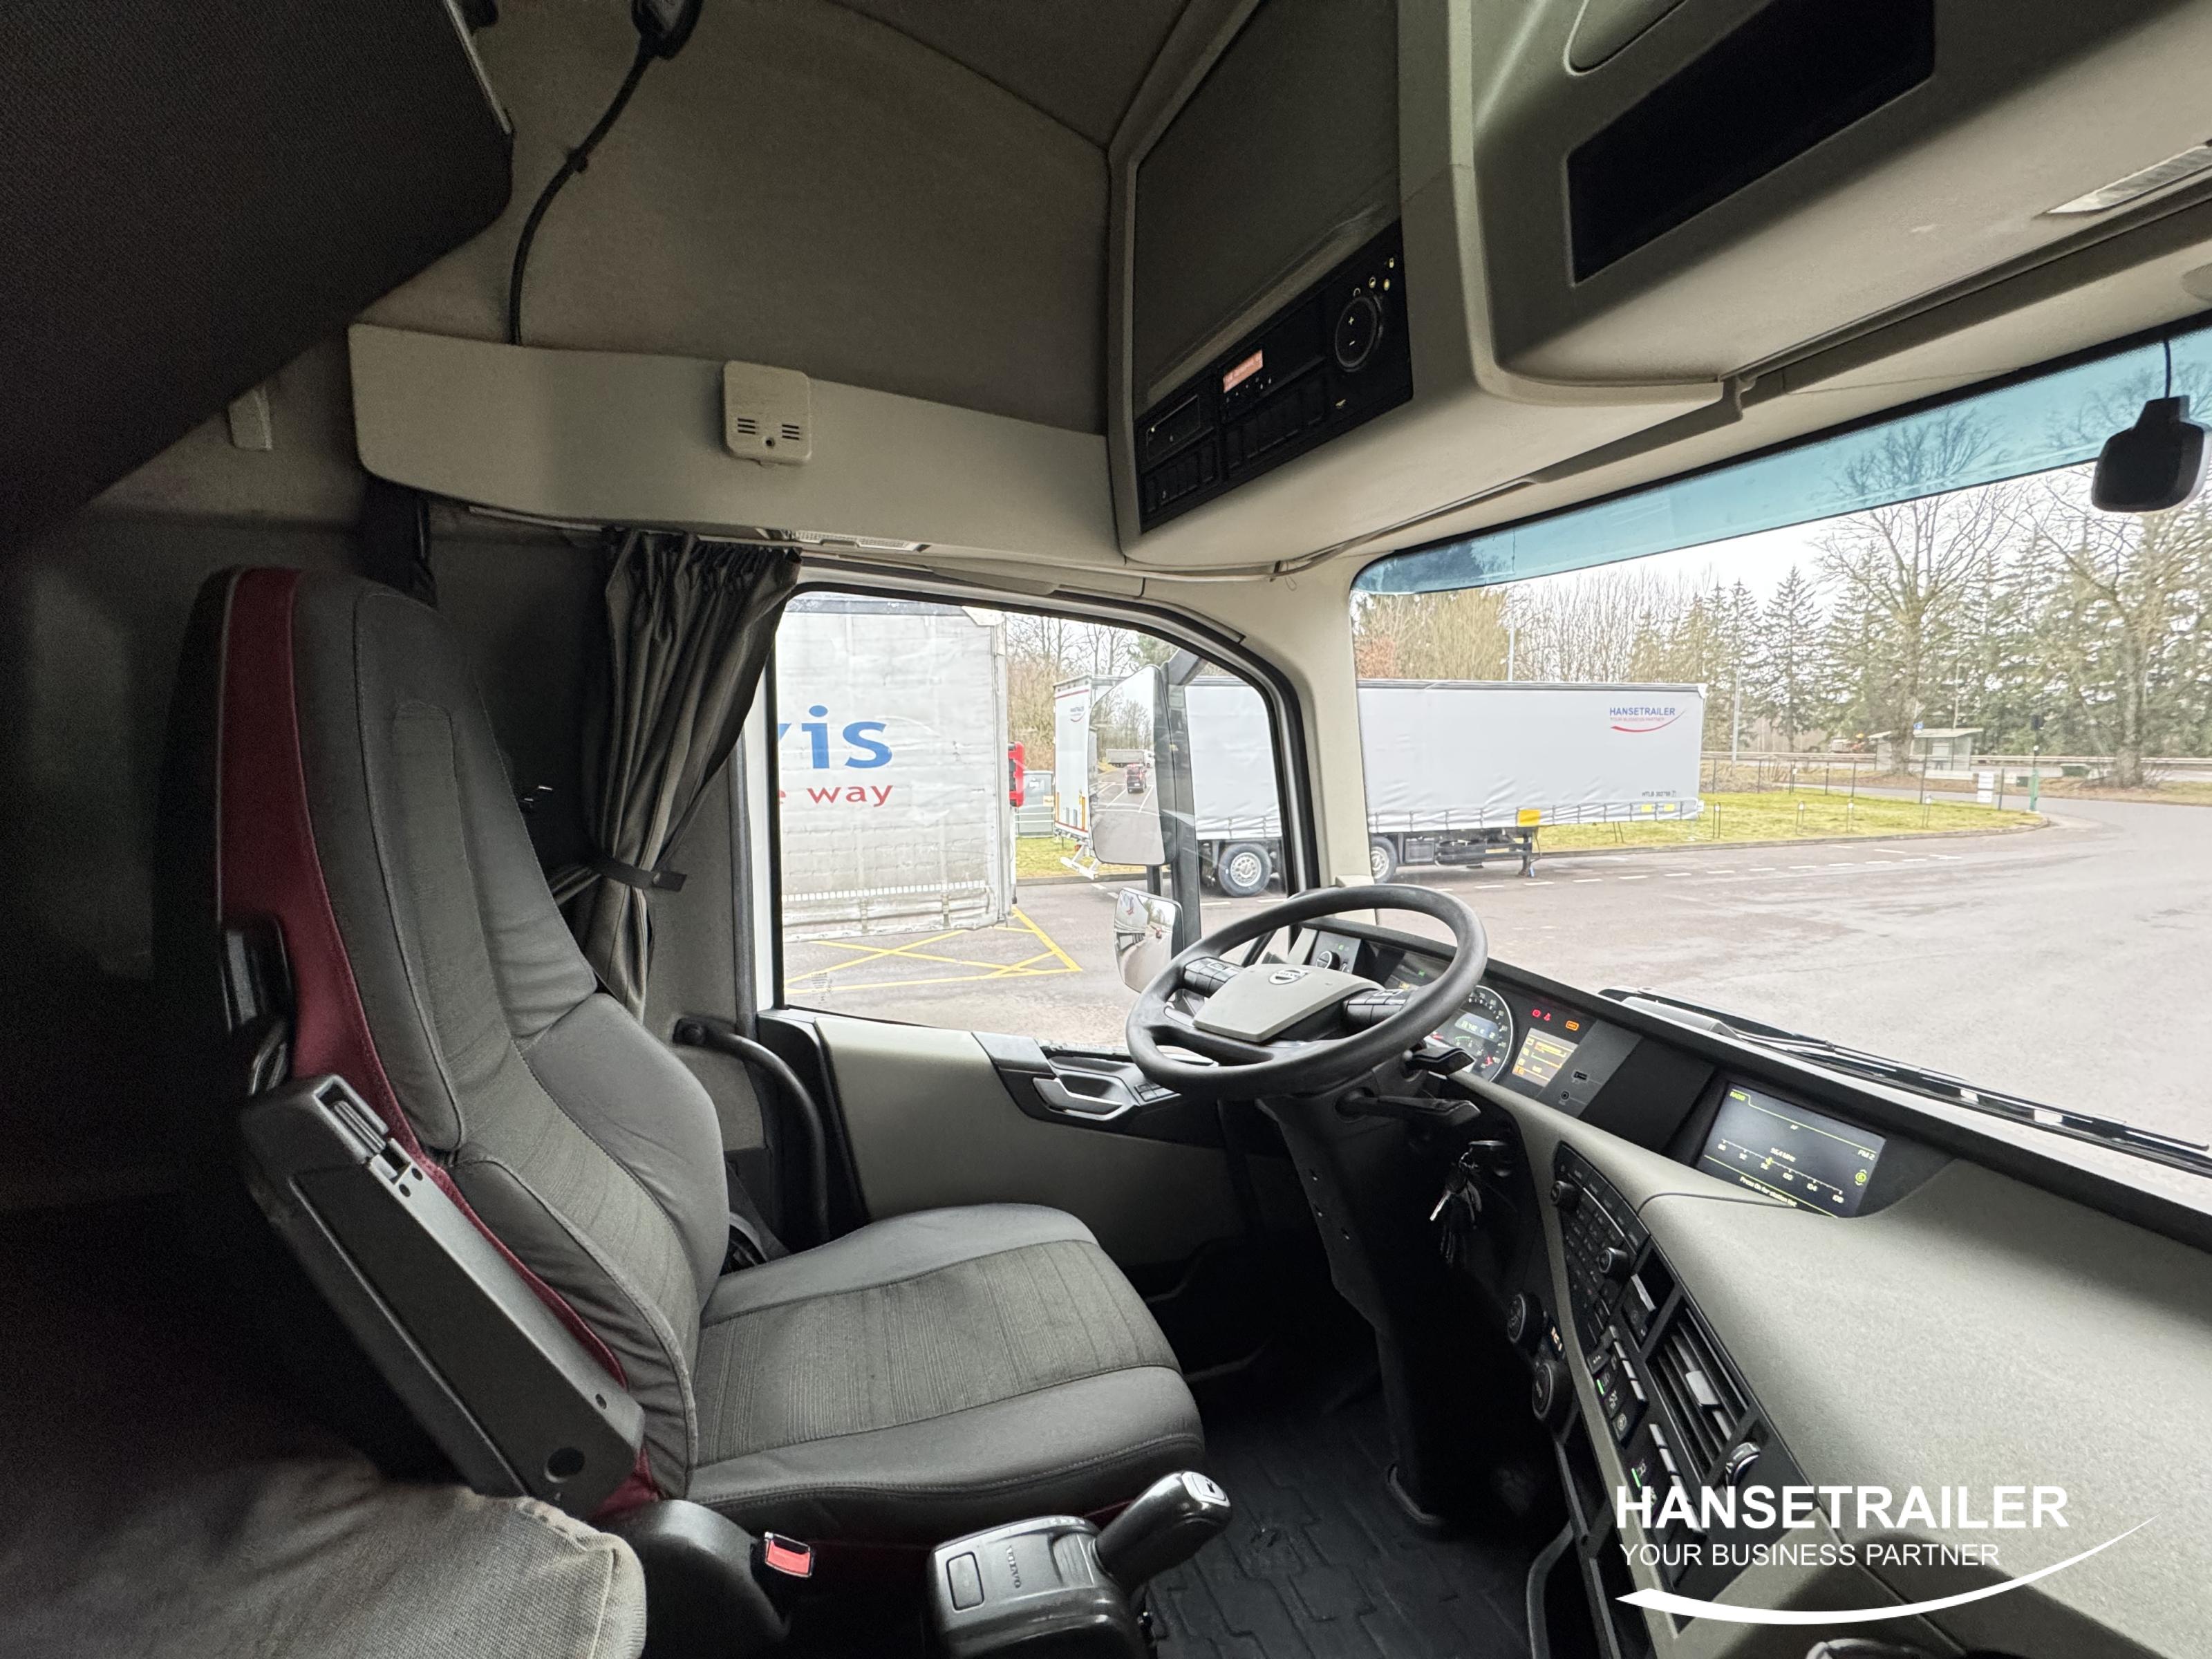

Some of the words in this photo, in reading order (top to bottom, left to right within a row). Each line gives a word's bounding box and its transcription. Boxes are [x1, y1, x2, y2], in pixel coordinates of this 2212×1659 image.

[1610, 707, 1676, 716] HANSETRAILER
[807, 785, 893, 807] way
[1857, 1150, 1869, 1159] FM
